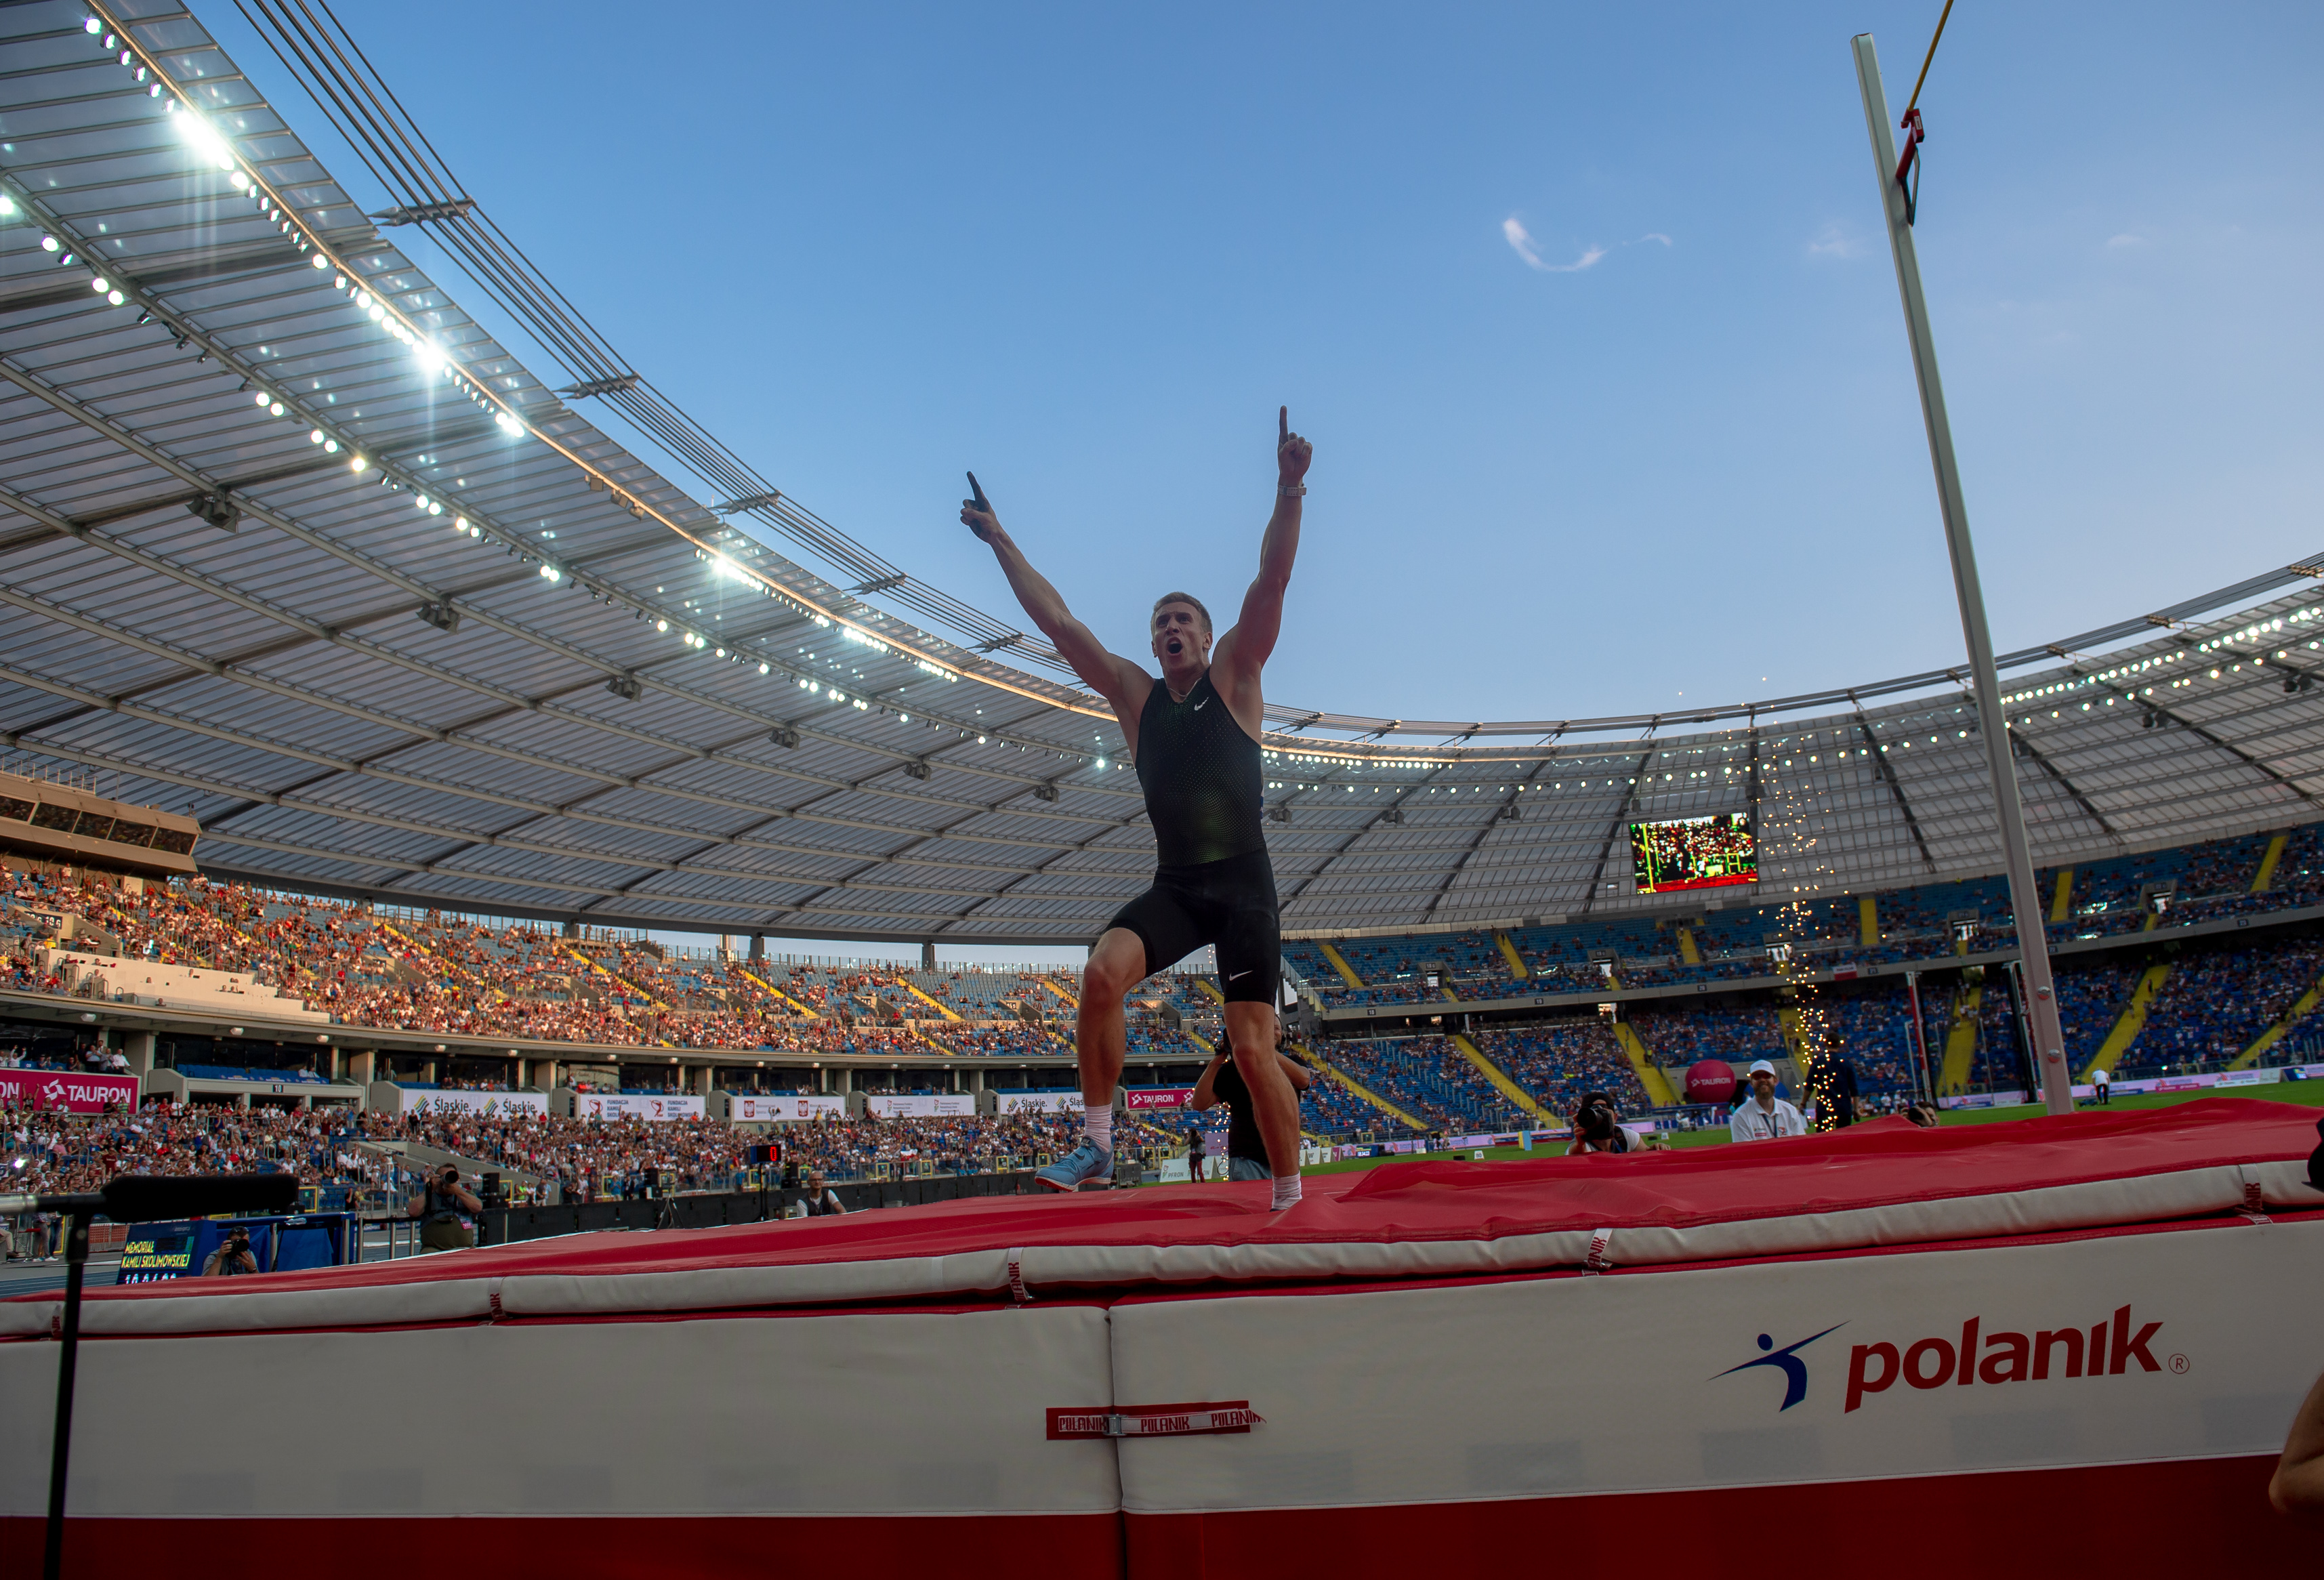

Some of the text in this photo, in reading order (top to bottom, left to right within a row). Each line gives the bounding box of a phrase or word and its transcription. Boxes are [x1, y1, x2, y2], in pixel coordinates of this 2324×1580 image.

[1700, 1077, 1731, 1085] TAURON
[67, 1085, 131, 1103] TAURON
[1142, 1094, 1174, 1103] TAURON
[770, 1146, 777, 1161] 0
[121, 1253, 190, 1268] KAMILI SKOLIMOWSKIEJ
[1844, 1304, 2164, 1414] polanik
[1140, 1416, 1190, 1433] POLANIK
